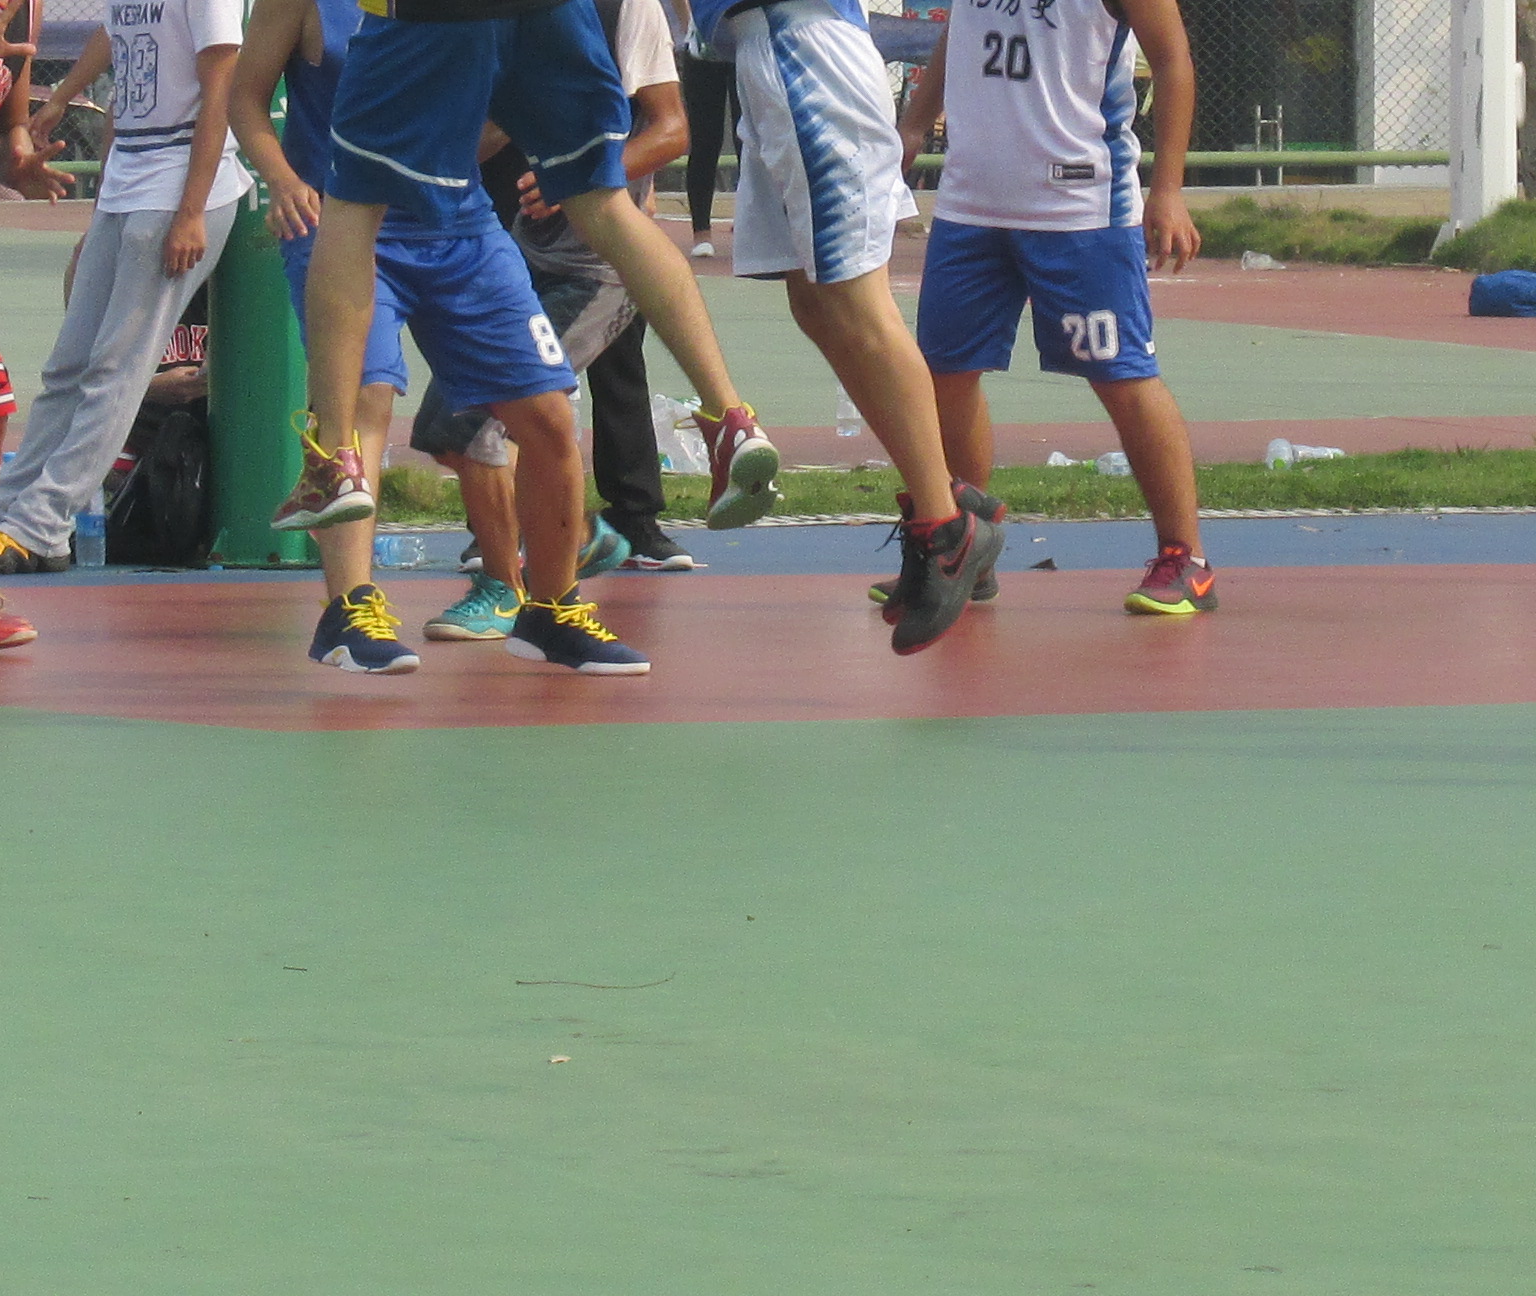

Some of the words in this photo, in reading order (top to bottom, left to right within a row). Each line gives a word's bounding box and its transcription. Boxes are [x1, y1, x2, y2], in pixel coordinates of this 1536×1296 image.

[983, 31, 1031, 81] 20
[528, 312, 565, 366] 8
[1061, 310, 1120, 362] 20
